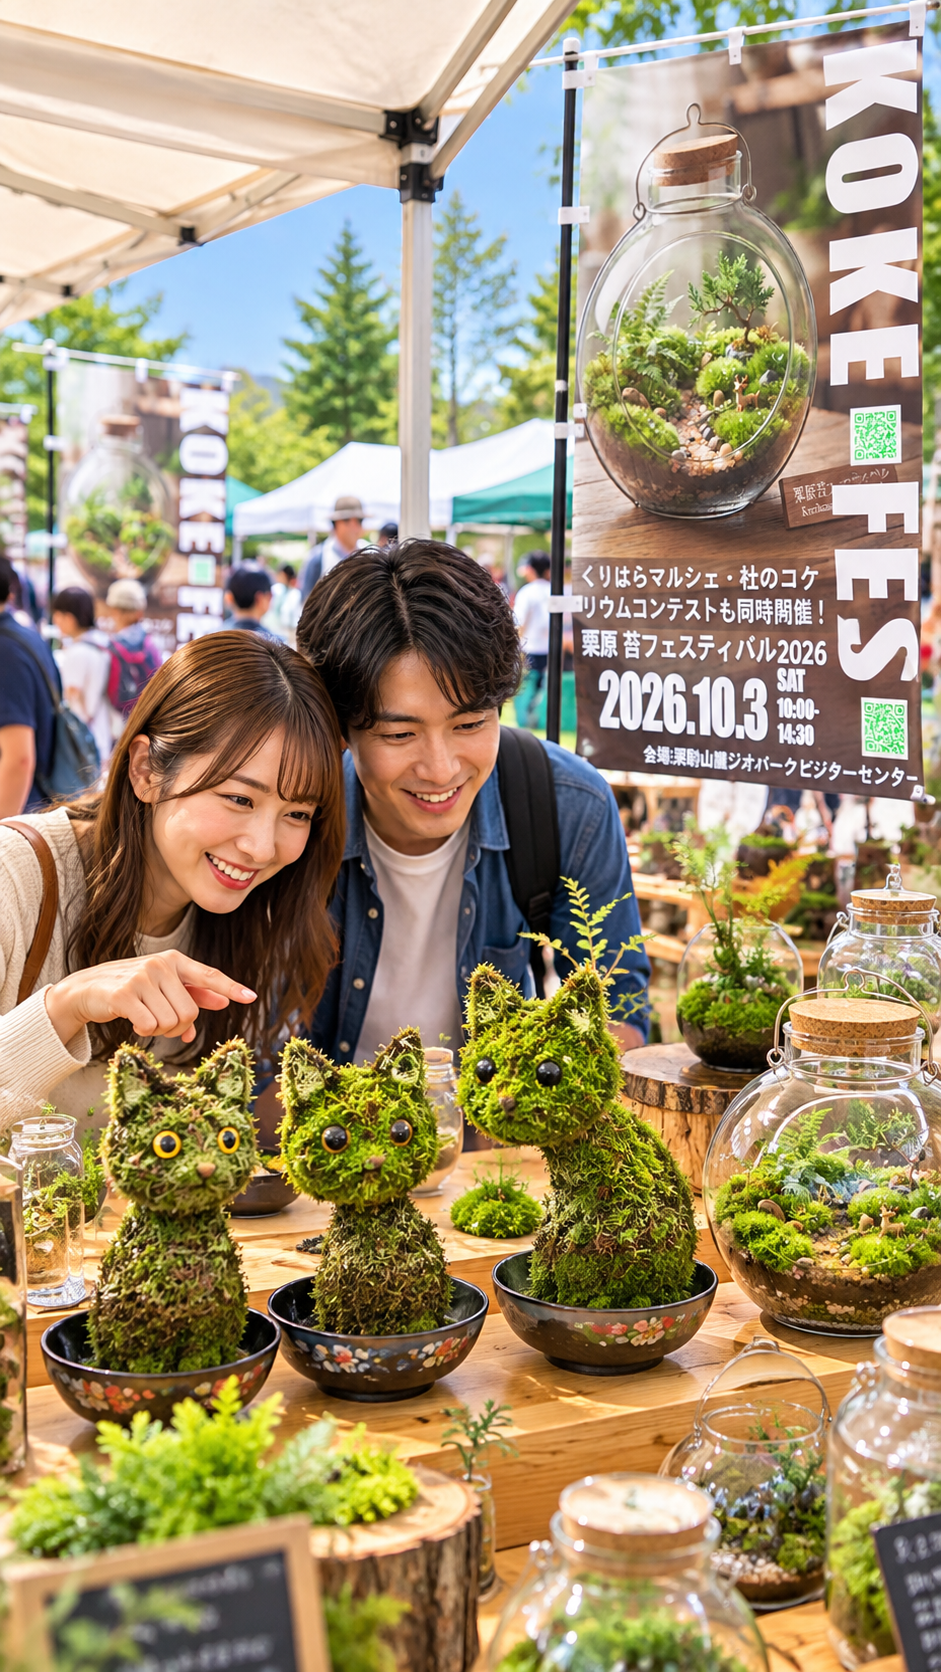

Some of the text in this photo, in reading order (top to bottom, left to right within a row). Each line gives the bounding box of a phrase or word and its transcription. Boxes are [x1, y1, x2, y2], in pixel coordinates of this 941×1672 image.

[823, 39, 920, 386] KOKE
[176, 387, 230, 651] KOKE FE
[581, 565, 819, 591] くりはらマルシェ・杜のコケ
[832, 481, 920, 682] FES
[581, 629, 619, 659] 栗原
[777, 667, 806, 693] SAT
[598, 669, 769, 742] 2026.10.3
[777, 697, 820, 721] 10:00-
[777, 723, 815, 747] 14:30
